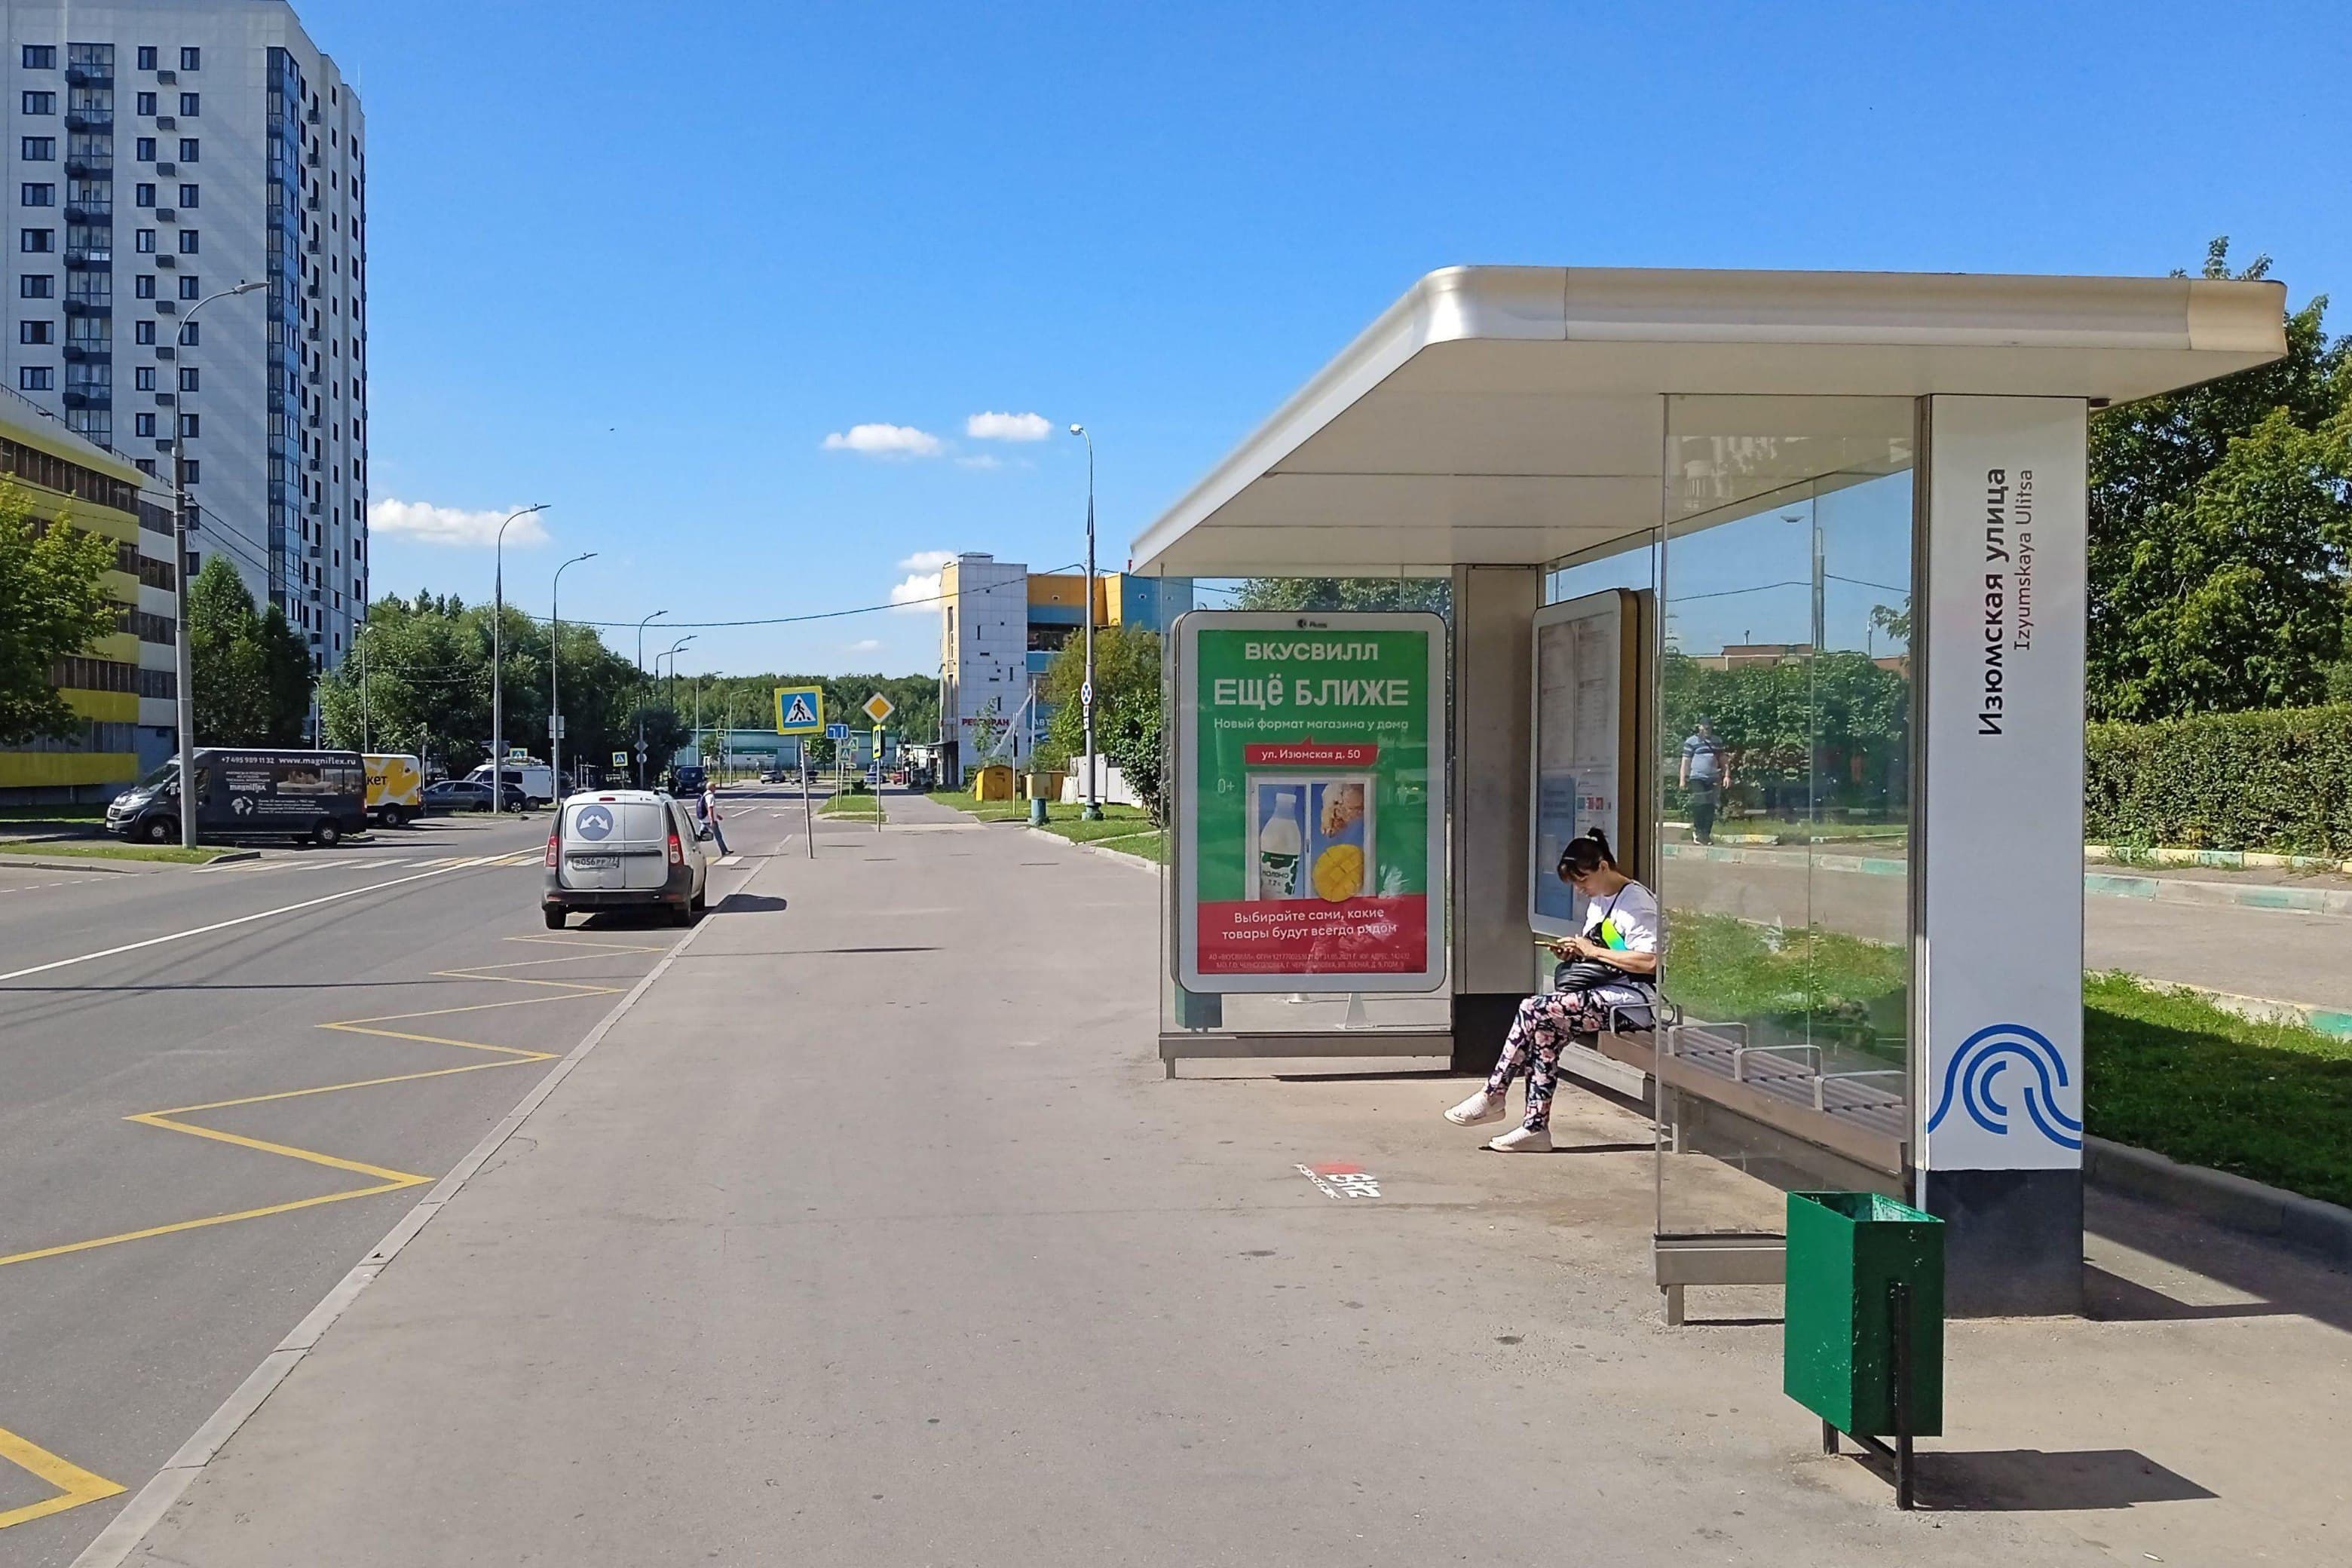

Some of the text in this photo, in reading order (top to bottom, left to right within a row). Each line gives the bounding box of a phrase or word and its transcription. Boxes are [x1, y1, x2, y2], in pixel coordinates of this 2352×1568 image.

[2014, 470, 2035, 651] Izyumskaya Ulitsa
[1979, 468, 2010, 736] Изюмская улица
[1245, 642, 1379, 661] ВКУСВИЛЛ
[1295, 679, 1409, 706] БЛИЖЕ
[1214, 718, 1409, 733] Новый формат магазина у дома
[278, 757, 357, 767] www.magniflex.ru
[1261, 749, 1361, 761] ул. Изюмская д. 50
[1217, 778, 1236, 794] 0+
[1234, 908, 1384, 925] Выбирайте сами, какие
[1222, 924, 1397, 941] товары будут всегда рядом
